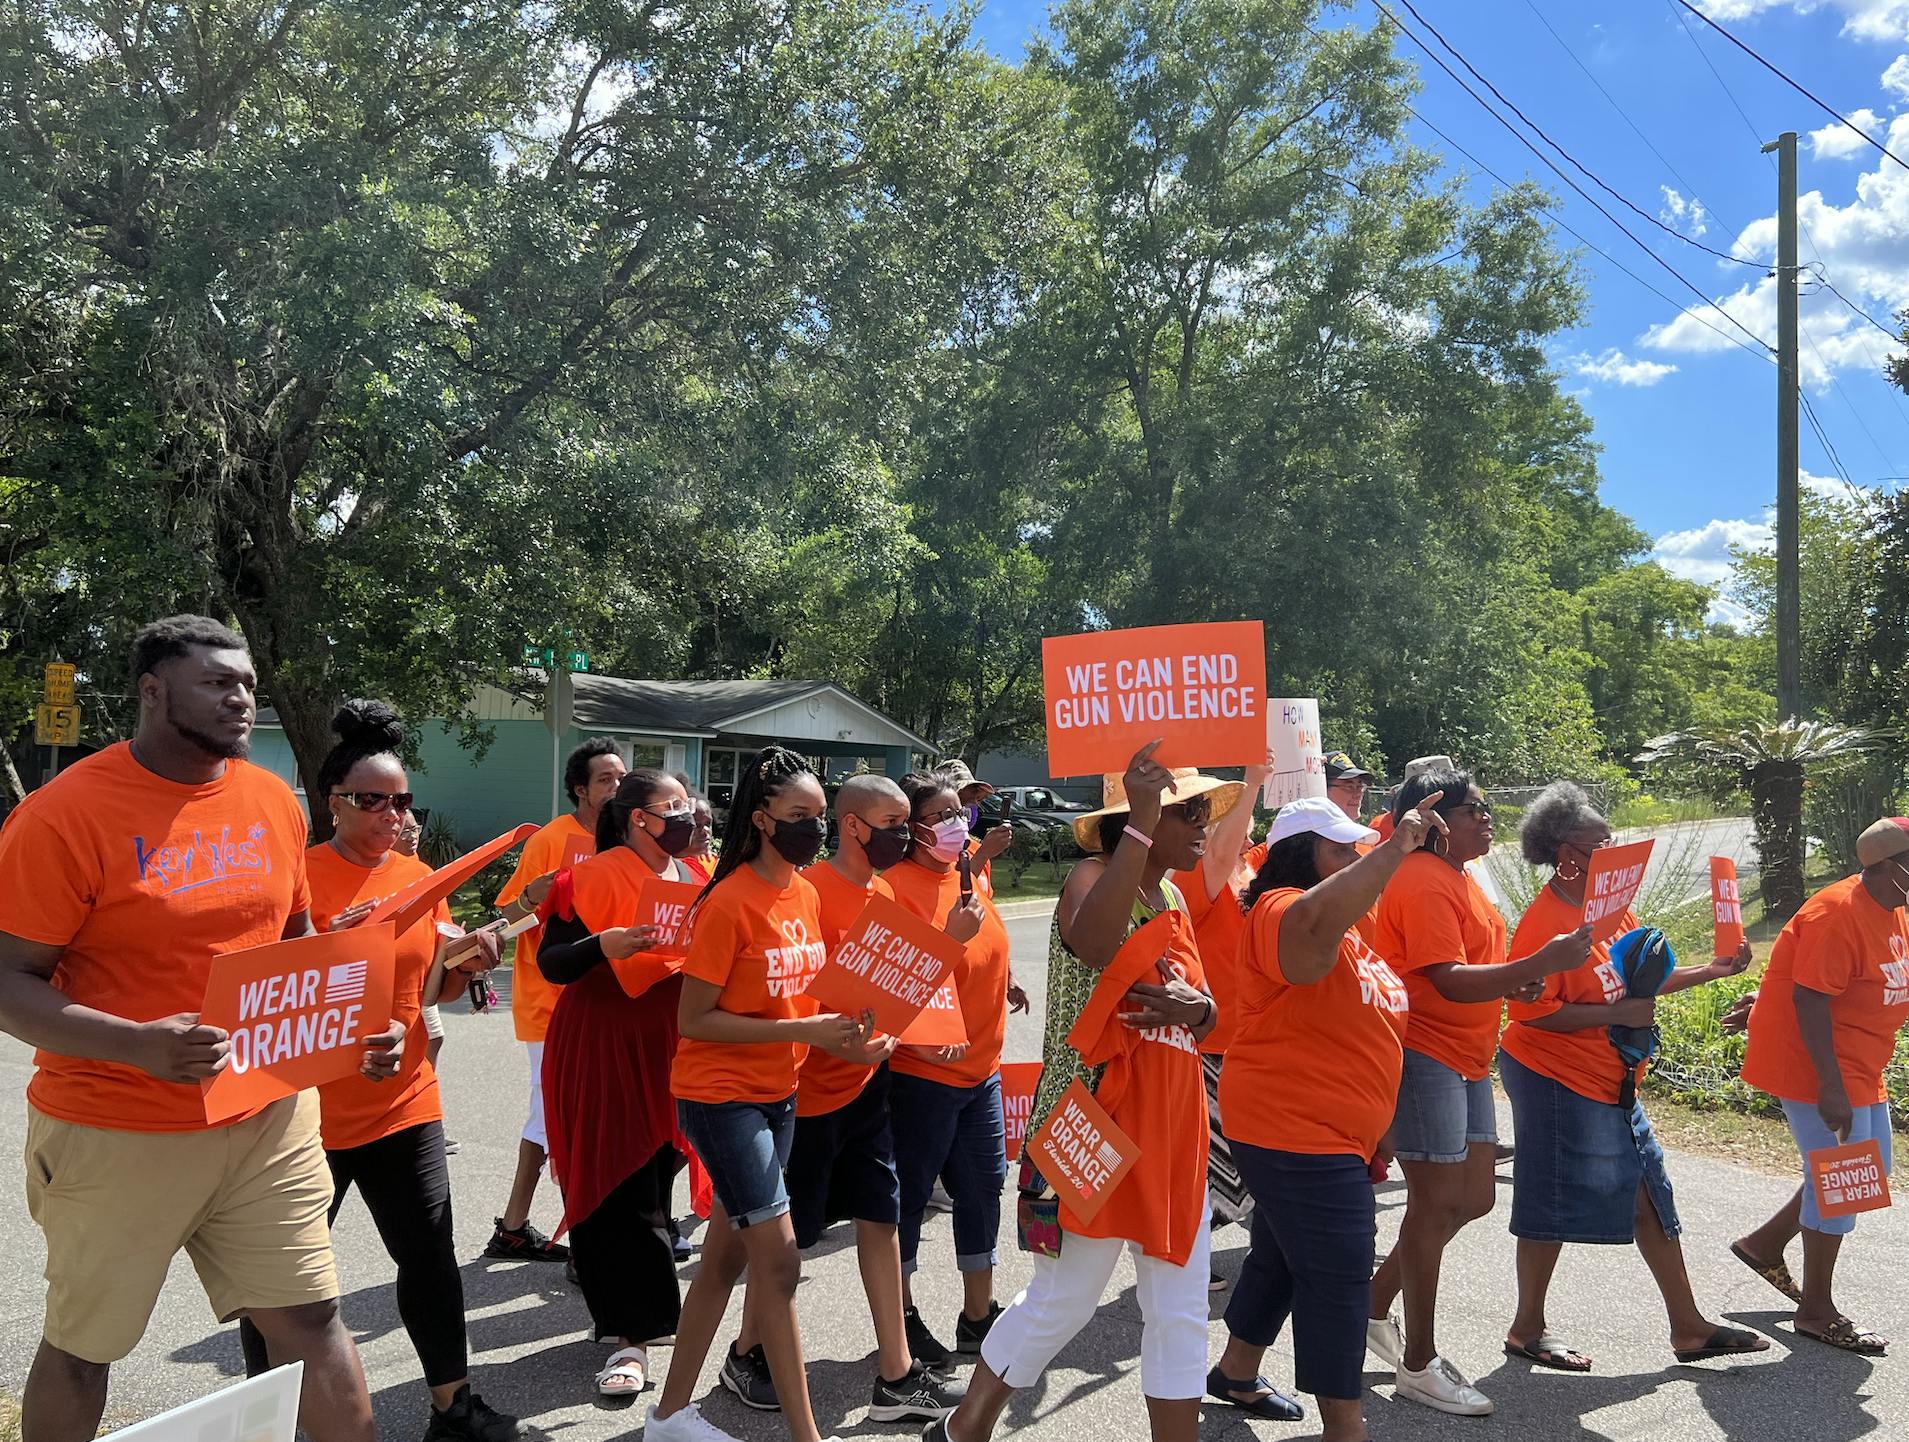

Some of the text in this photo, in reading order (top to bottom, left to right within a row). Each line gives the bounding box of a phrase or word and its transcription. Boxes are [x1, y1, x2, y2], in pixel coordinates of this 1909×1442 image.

[575, 653, 587, 670] PL
[1065, 653, 1238, 695] WE CAN END
[46, 710, 71, 728] 15
[1055, 686, 1256, 729] GUN VIOLENCE
[1283, 705, 1304, 725] HOW
[1594, 870, 1611, 897] WE
[1610, 867, 1634, 893] CAN
[1717, 879, 1730, 900] WE
[654, 901, 685, 927] WE
[1584, 897, 1608, 924] GUN
[1716, 901, 1732, 923] GUN
[765, 941, 826, 977] END GU
[861, 920, 943, 983] WE CAN END
[835, 941, 876, 977] GUN
[870, 959, 934, 1008] VIOLENCE
[239, 969, 321, 1022] WEAR
[230, 1004, 363, 1075] ORANGE
[1063, 1098, 1101, 1150] WEAR
[1043, 1139, 1072, 1178] Florida
[1051, 1117, 1110, 1192] ORANGE
[1820, 1165, 1879, 1190] ORANGE
[1845, 1182, 1882, 1201] WEAR
